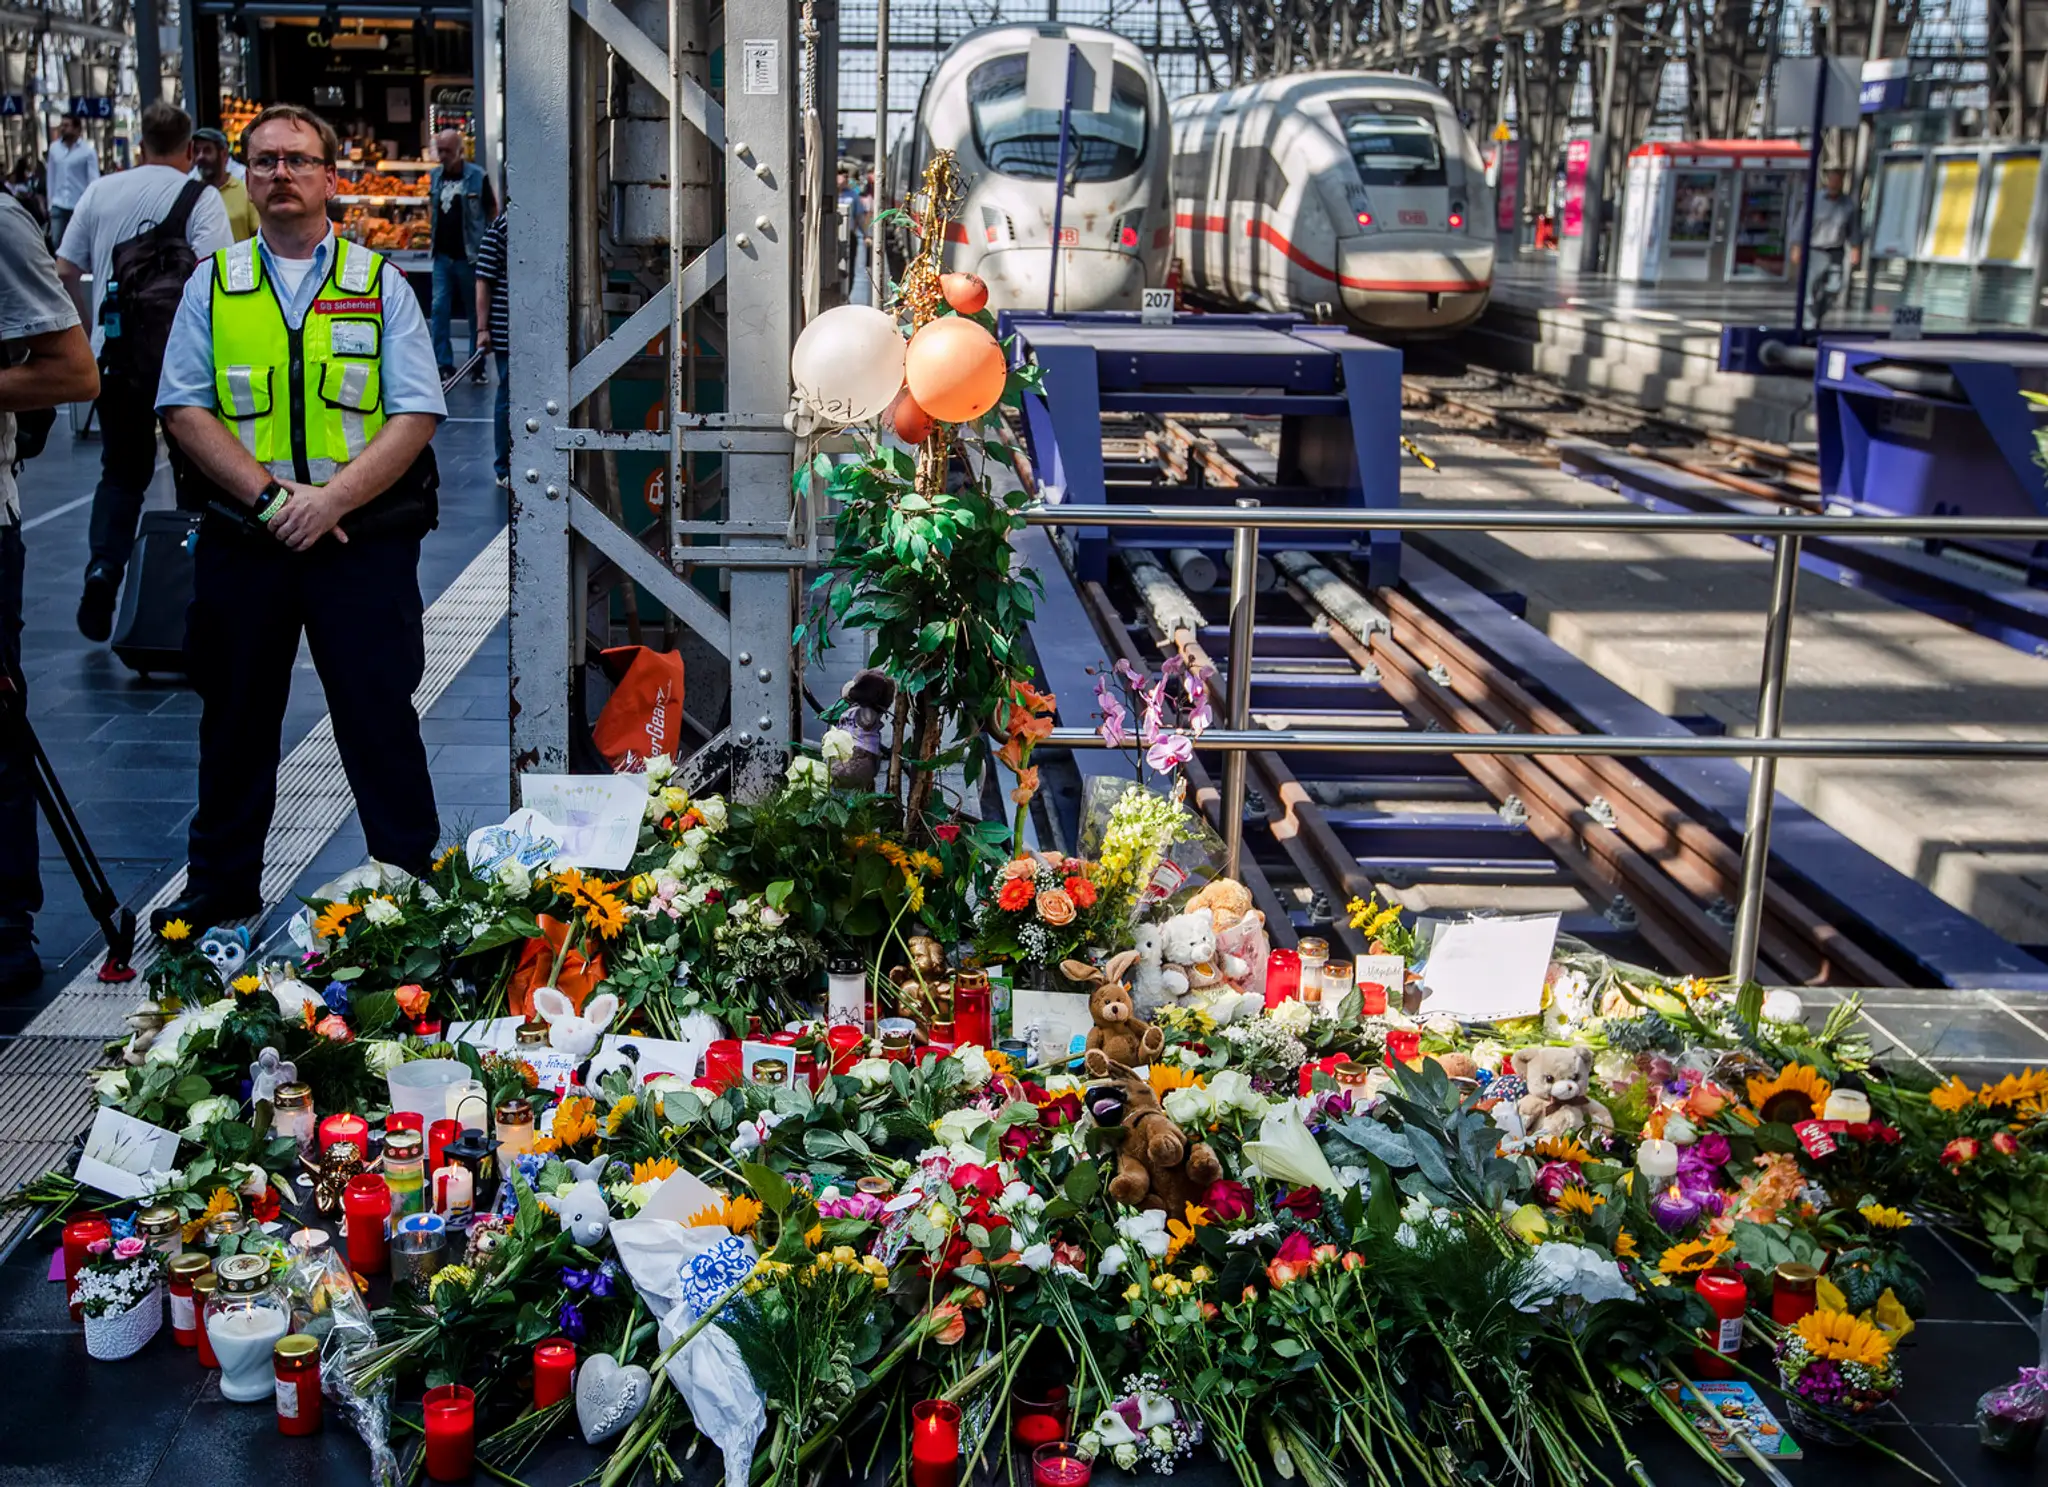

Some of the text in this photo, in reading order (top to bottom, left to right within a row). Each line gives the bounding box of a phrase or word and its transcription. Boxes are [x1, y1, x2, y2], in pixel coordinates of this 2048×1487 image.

[3, 96, 16, 113] A
[76, 98, 110, 116] A 5
[320, 300, 376, 311] DB Sicherheit
[1145, 292, 1171, 308] 207
